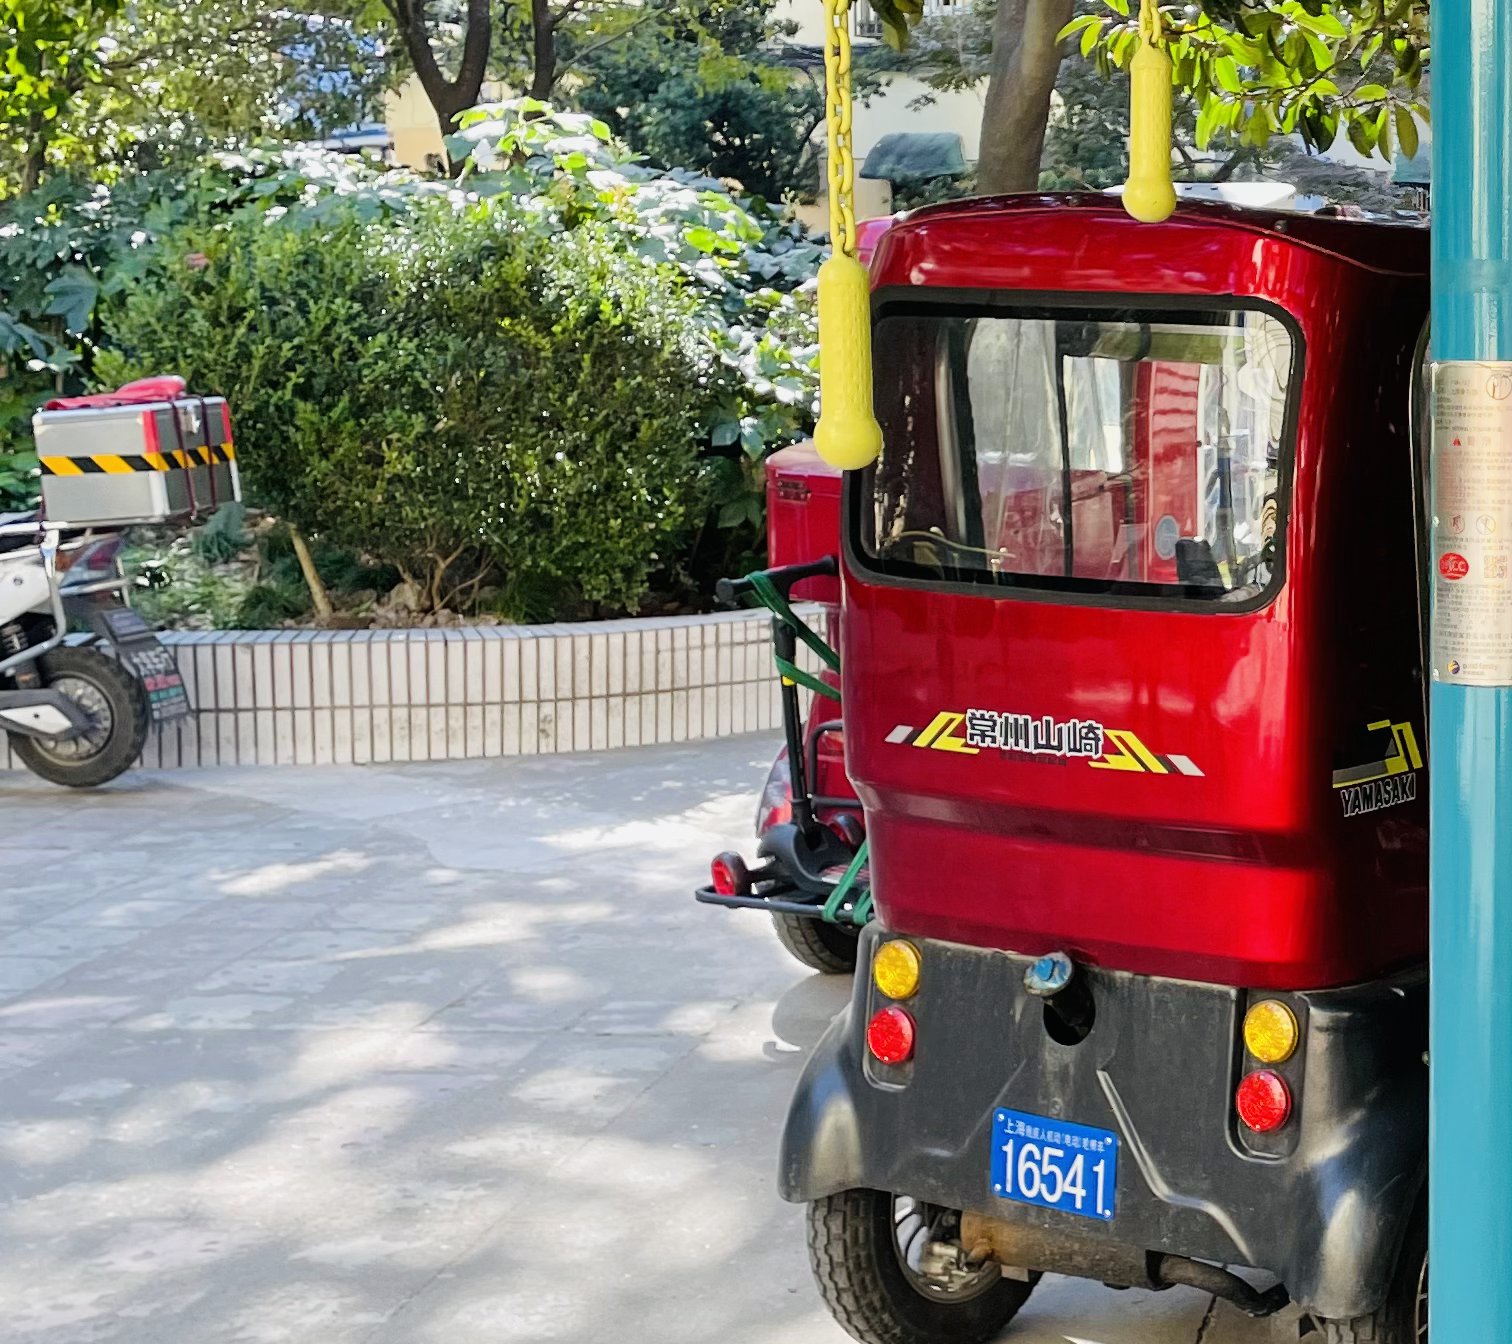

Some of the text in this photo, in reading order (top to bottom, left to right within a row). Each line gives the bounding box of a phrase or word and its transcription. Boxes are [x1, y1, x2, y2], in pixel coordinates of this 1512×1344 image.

[966, 709, 1103, 759] 常州山崎
[1341, 772, 1416, 817] YAMASAKI
[1002, 1139, 1105, 1214] 16541
